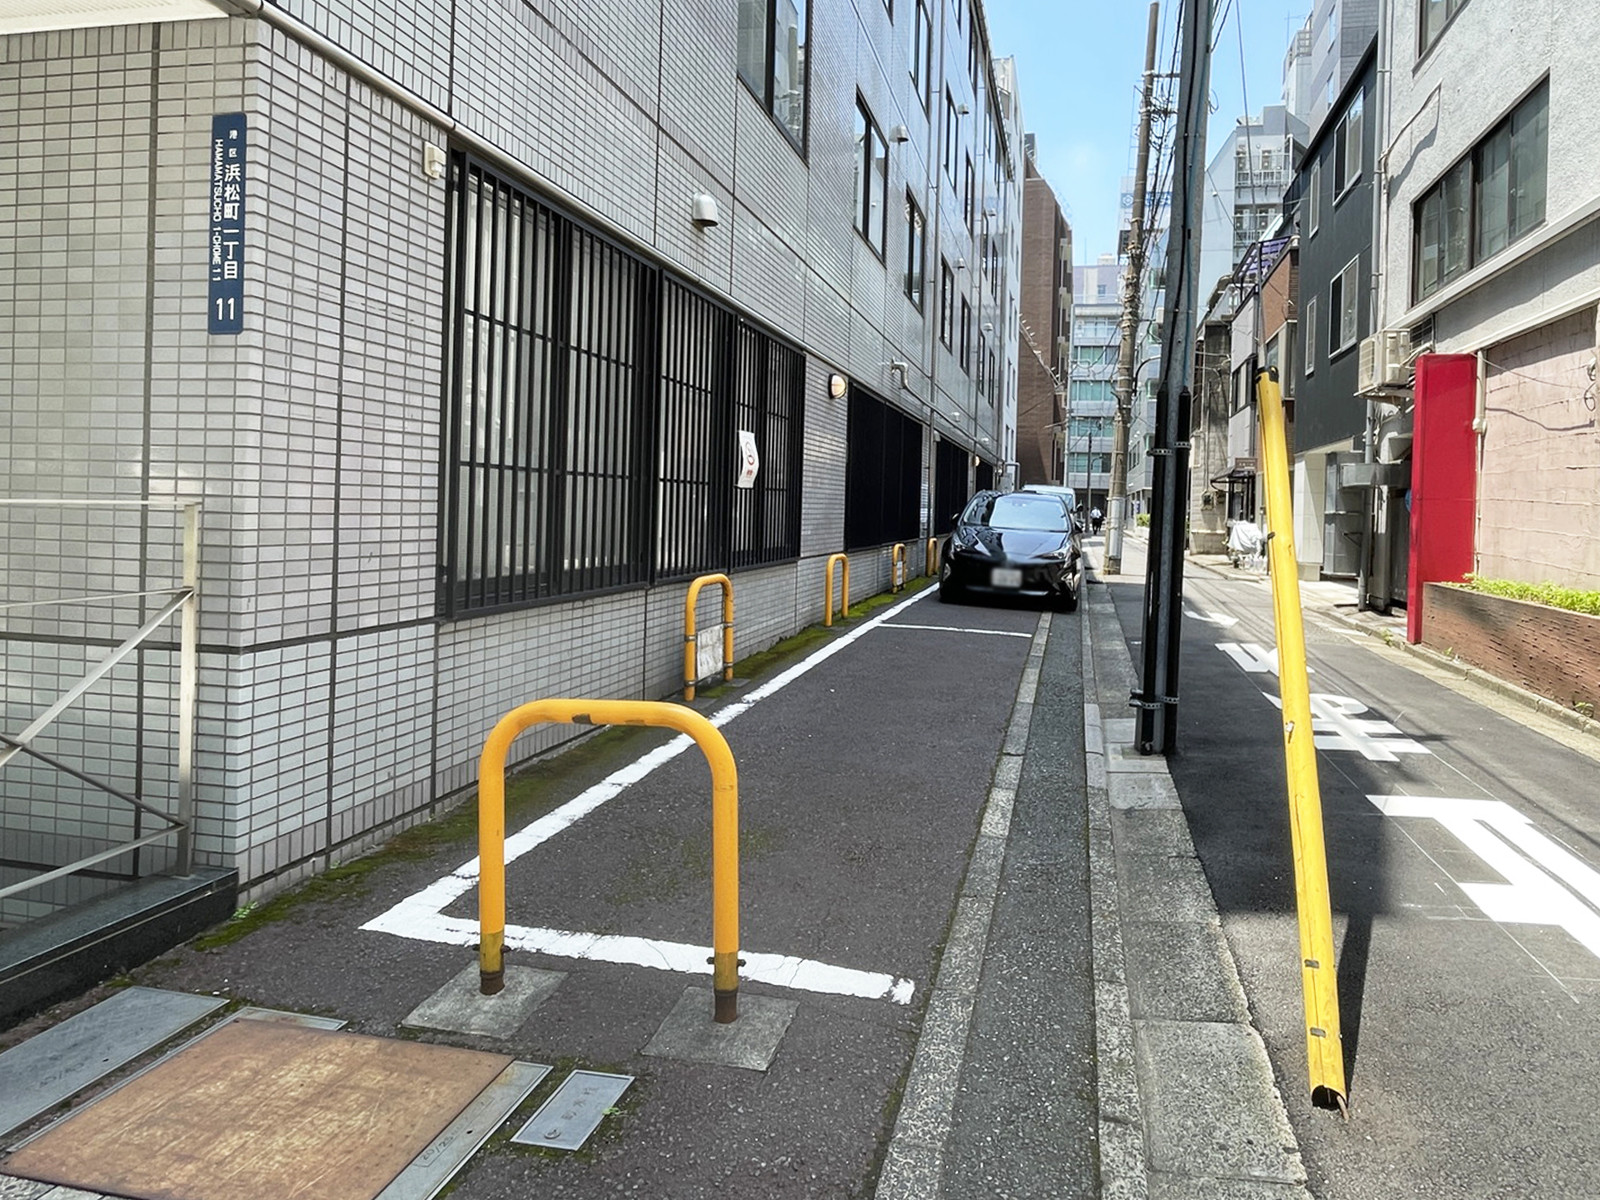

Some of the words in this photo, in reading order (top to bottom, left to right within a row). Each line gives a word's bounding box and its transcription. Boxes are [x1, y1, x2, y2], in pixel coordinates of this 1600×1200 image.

[212, 139, 224, 222] HAMAMATSUCHO
[212, 226, 222, 265] 1-CHOME
[222, 163, 241, 280] 浜松町一丁目
[216, 297, 235, 321] 11
